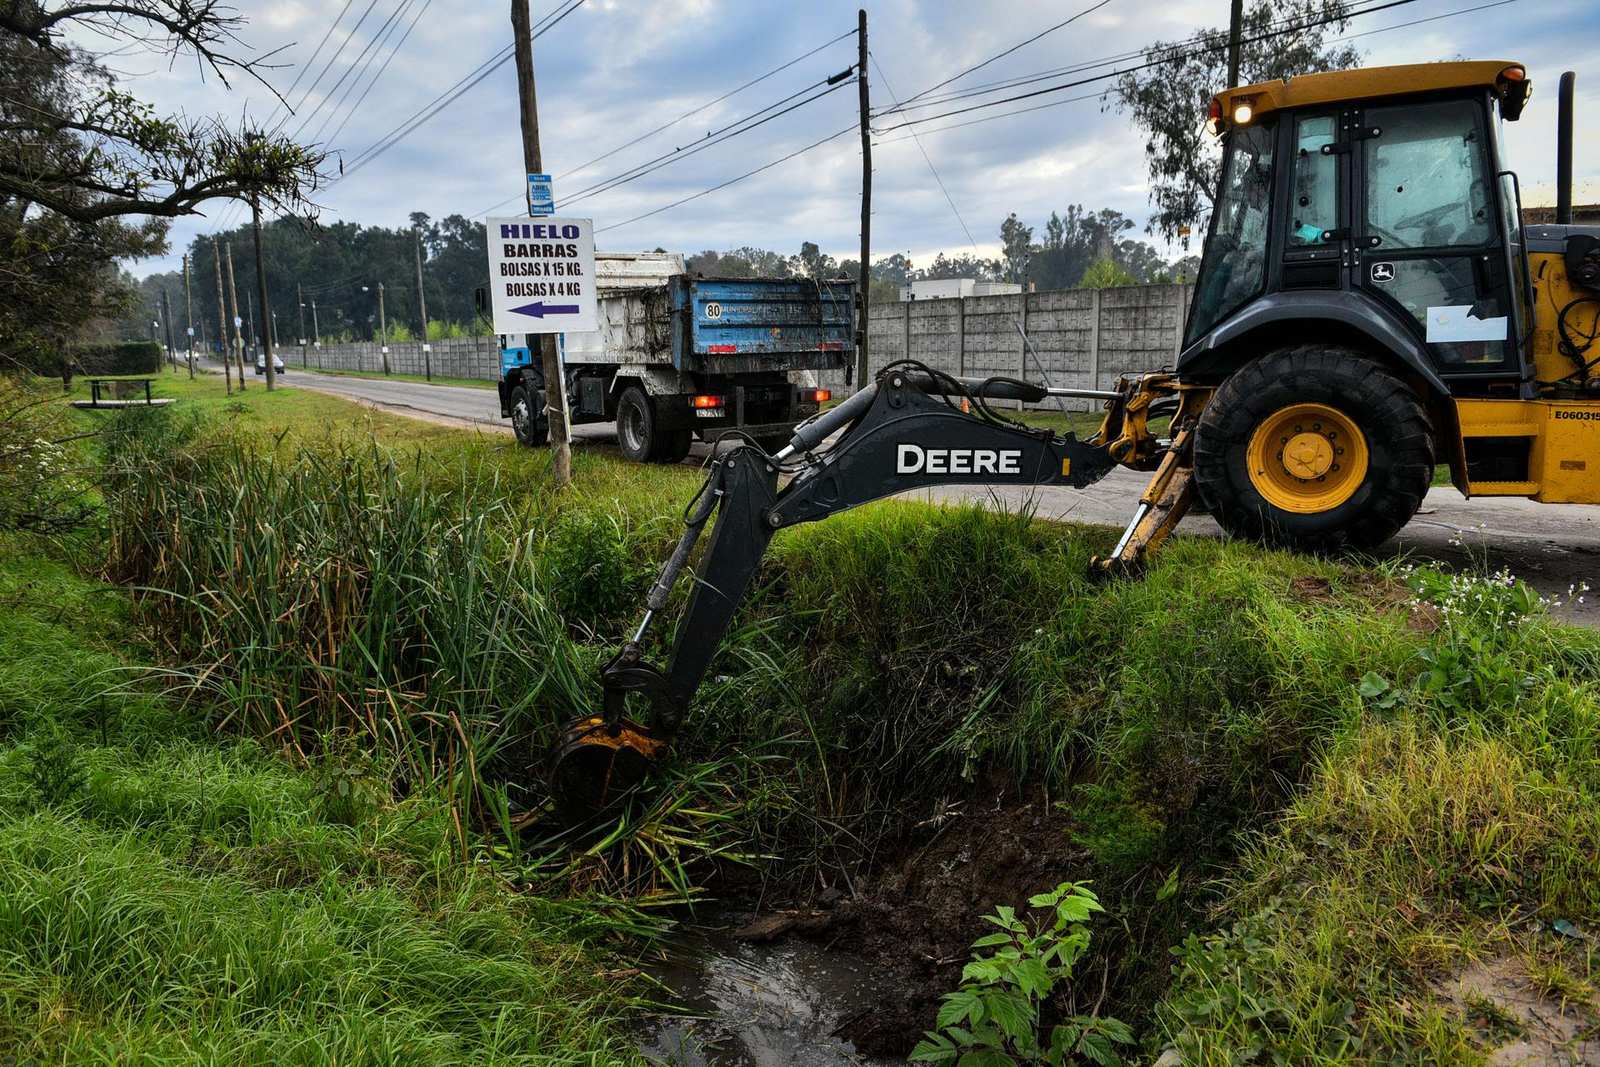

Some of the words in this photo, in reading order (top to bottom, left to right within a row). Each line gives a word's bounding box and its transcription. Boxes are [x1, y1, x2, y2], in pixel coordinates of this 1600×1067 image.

[500, 224, 580, 240] HIELO
[503, 244, 578, 258] BARRAS
[500, 263, 542, 276] BOLSAS
[543, 262, 551, 276] X
[552, 262, 565, 276] 15
[566, 262, 584, 276] KG.
[506, 283, 546, 297] BOLSAS
[549, 283, 556, 296] X
[558, 283, 564, 296] 4
[566, 282, 581, 296] KG
[707, 304, 721, 317] 80
[896, 444, 1022, 474] DEERE
